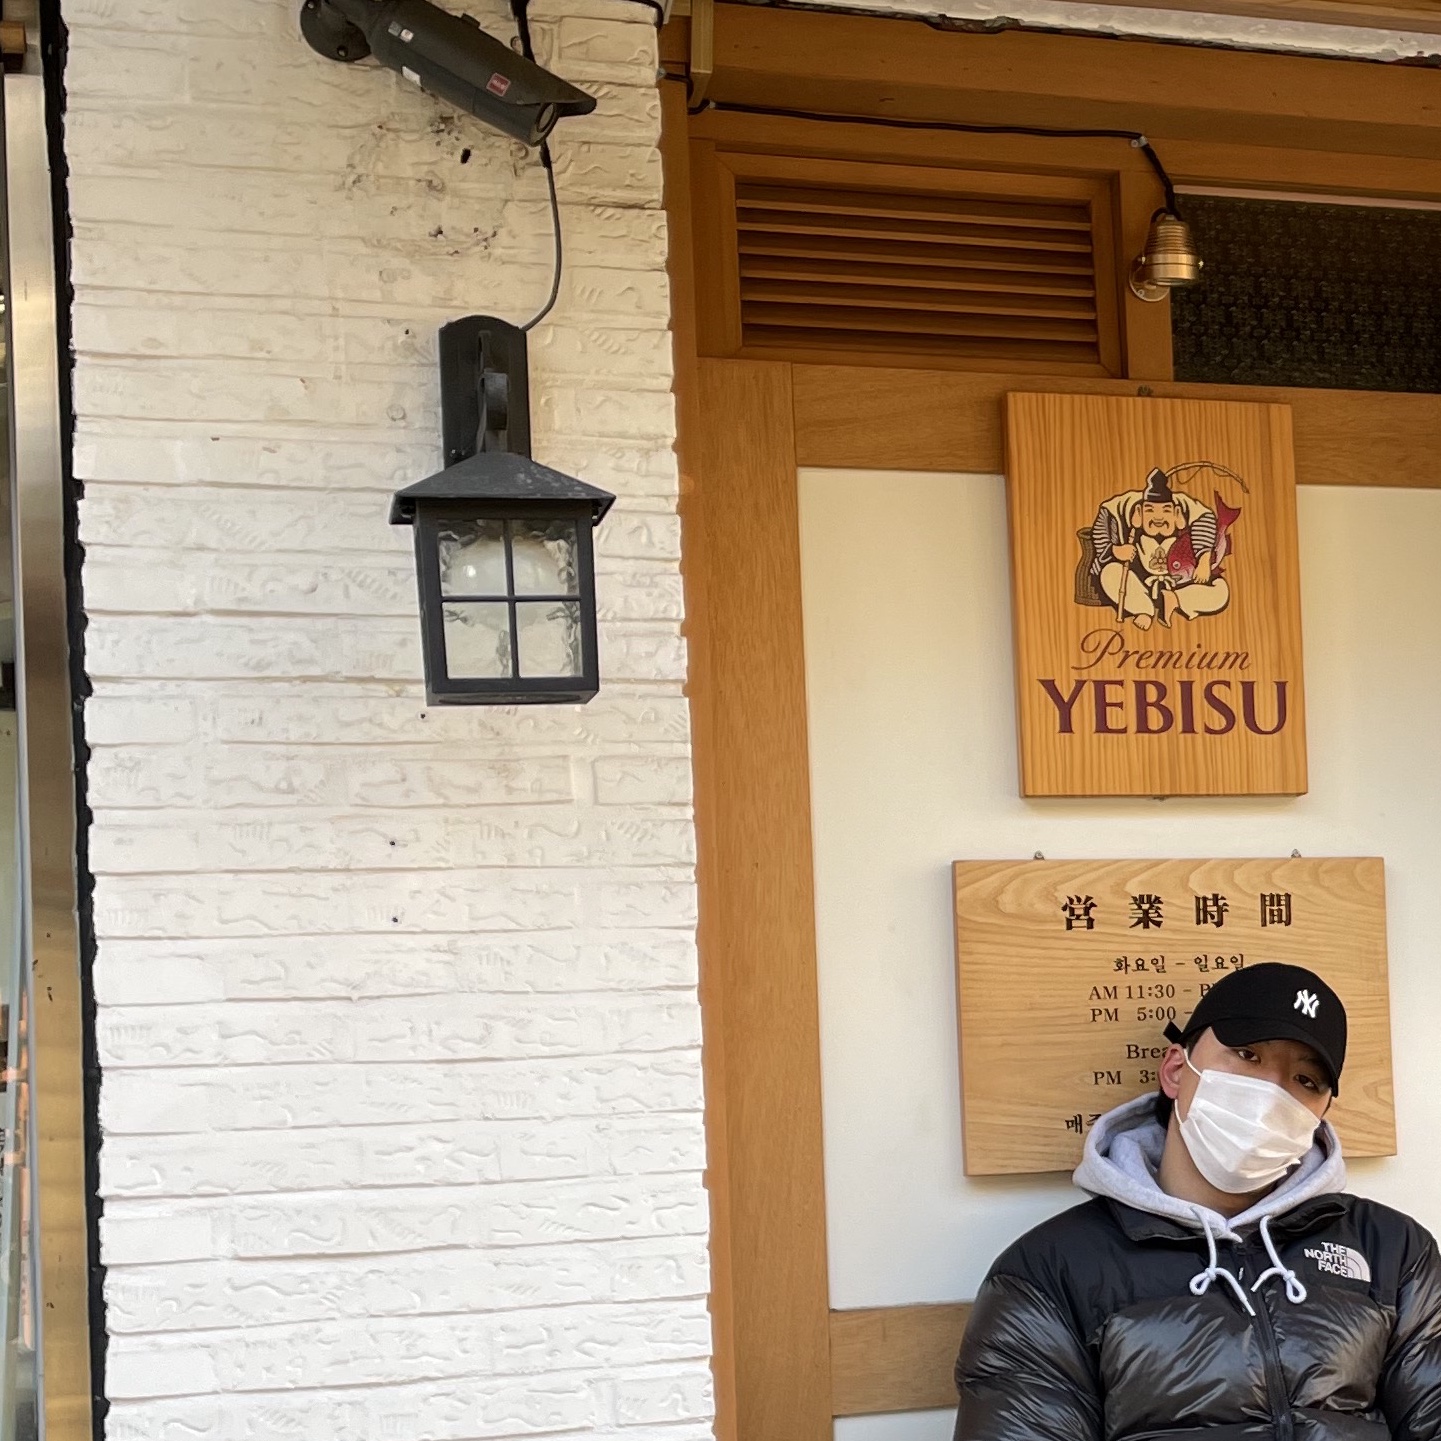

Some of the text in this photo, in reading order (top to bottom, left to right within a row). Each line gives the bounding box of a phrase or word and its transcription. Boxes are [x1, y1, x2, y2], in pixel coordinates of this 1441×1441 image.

[1071, 628, 1251, 671] Premium
[1036, 678, 1289, 736] YEBISU
[1061, 892, 1293, 931] 営業時間
[1113, 955, 1167, 975] 화요일
[1193, 953, 1245, 973] 일요일
[1088, 986, 1119, 1000] AM
[1125, 984, 1176, 999] 11:30
[1293, 988, 1320, 1019] NY
[1090, 1008, 1119, 1022] PM
[1136, 1006, 1177, 1021] 5:00
[1126, 1044, 1169, 1059] Brea
[1092, 1071, 1122, 1085] PM
[1303, 1248, 1347, 1266] NORTH
[1320, 1241, 1347, 1255] THE
[1317, 1259, 1348, 1278] FACE
